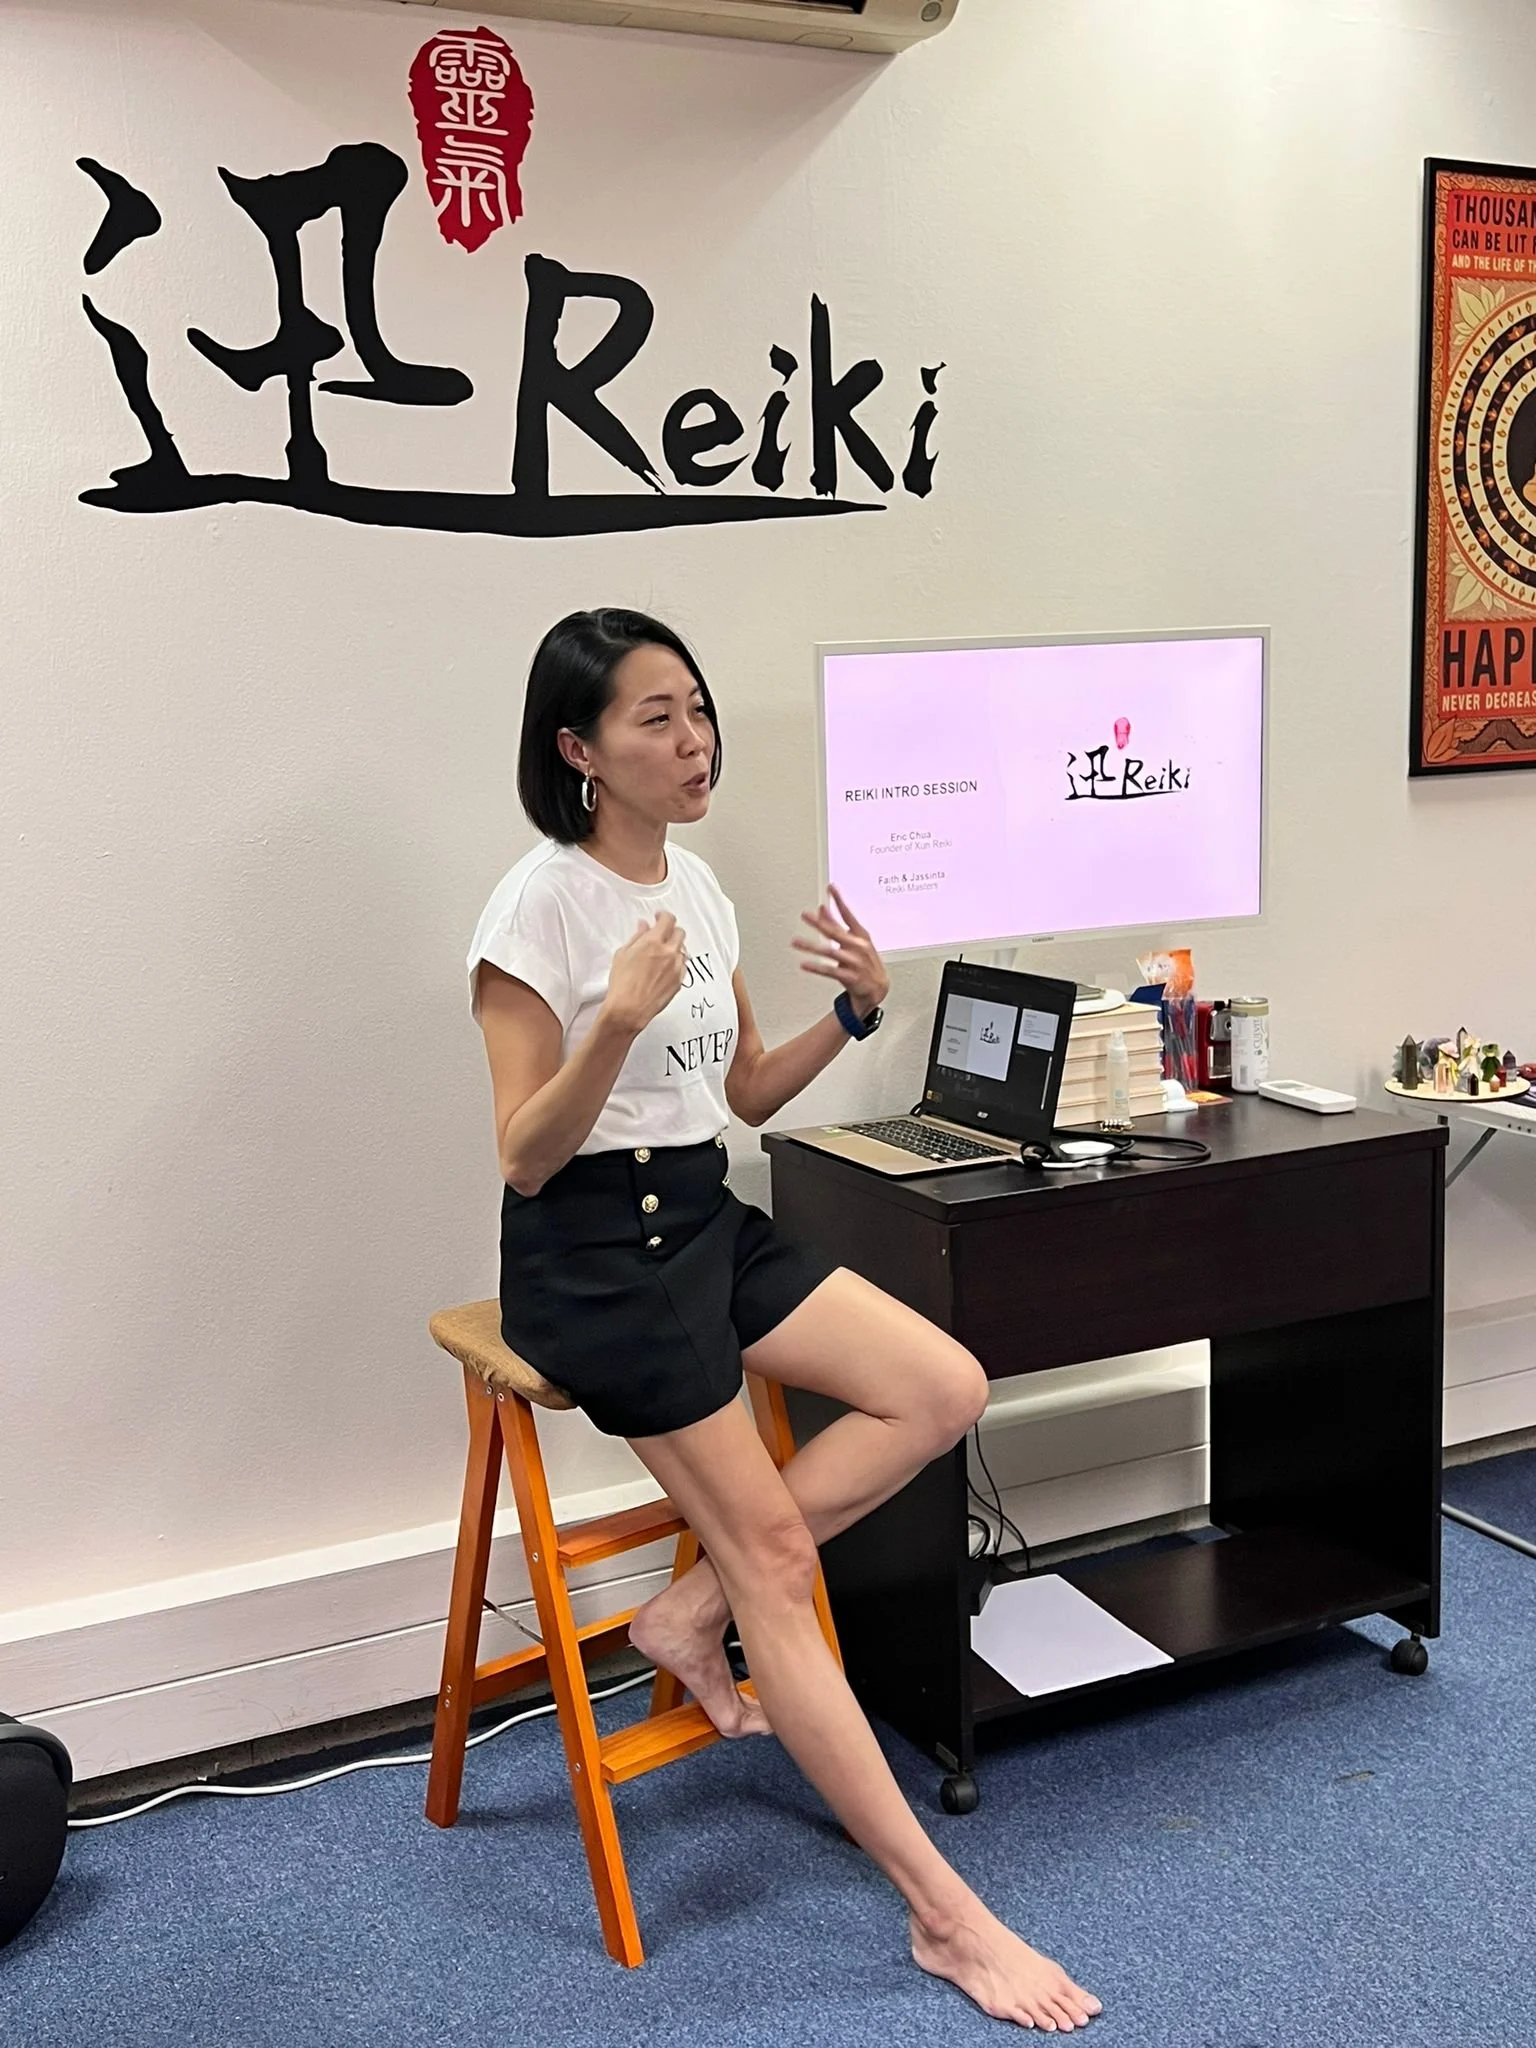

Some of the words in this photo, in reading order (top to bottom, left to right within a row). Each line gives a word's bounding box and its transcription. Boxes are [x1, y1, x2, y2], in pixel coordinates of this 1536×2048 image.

[1452, 229, 1479, 250] CAN
[1485, 232, 1501, 251] BE
[1507, 233, 1527, 254] LIT
[1452, 254, 1471, 269] AND
[1474, 255, 1490, 271] THE
[1493, 257, 1511, 272] LIFE
[1514, 258, 1525, 273] OF
[512, 253, 947, 498] Reiki
[1443, 627, 1536, 689] HAP
[1442, 693, 1480, 712] NEVER
[1122, 758, 1191, 796] Reiki
[845, 788, 878, 802] REIKI
[882, 785, 920, 799] INTRO
[923, 780, 978, 796] SESSION
[870, 844, 902, 855] Founder
[904, 841, 913, 851] of
[915, 841, 931, 851] Xun
[890, 832, 907, 842] Eric
[909, 831, 932, 840] Chua
[681, 953, 714, 988] OW
